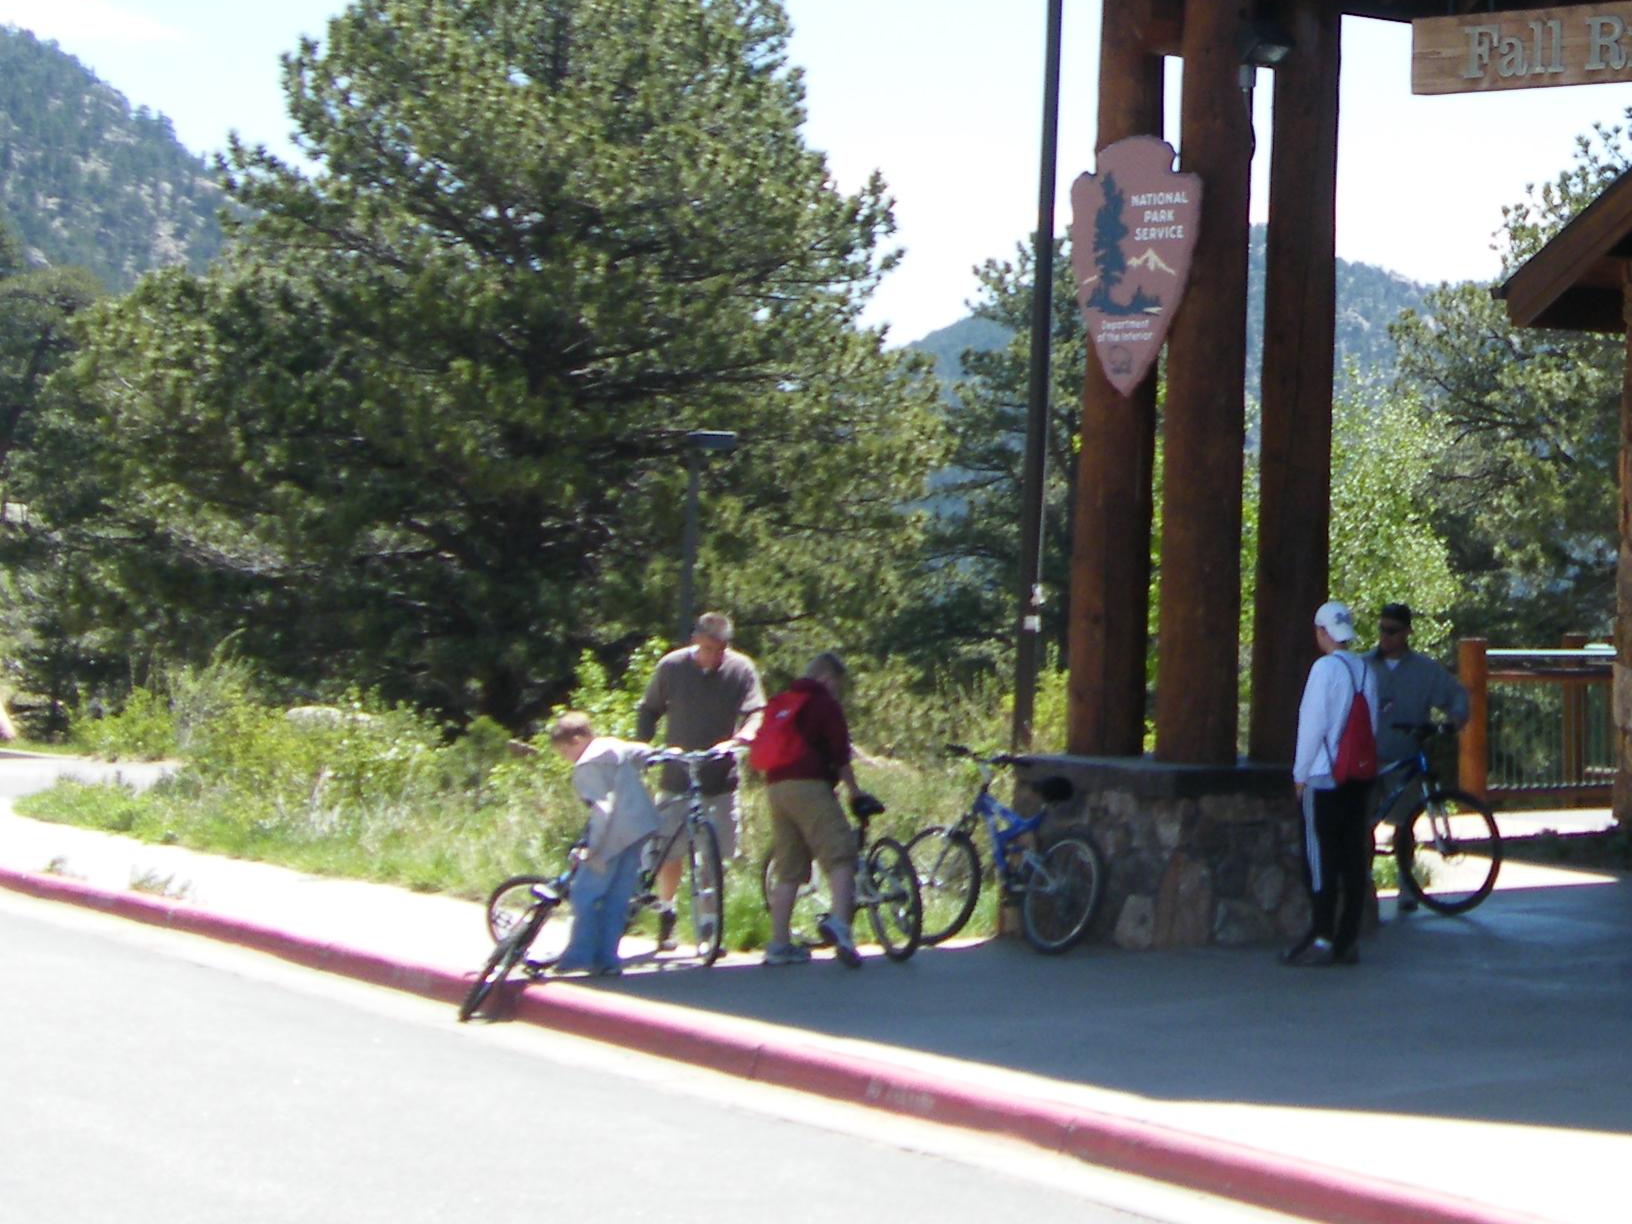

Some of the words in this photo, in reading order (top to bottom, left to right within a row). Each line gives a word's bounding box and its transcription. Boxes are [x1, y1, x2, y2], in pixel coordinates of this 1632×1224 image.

[1463, 18, 1566, 79] Fall
[1131, 191, 1189, 207] NATIONAL
[1143, 208, 1176, 224] PARK
[1134, 225, 1185, 241] SERVICE
